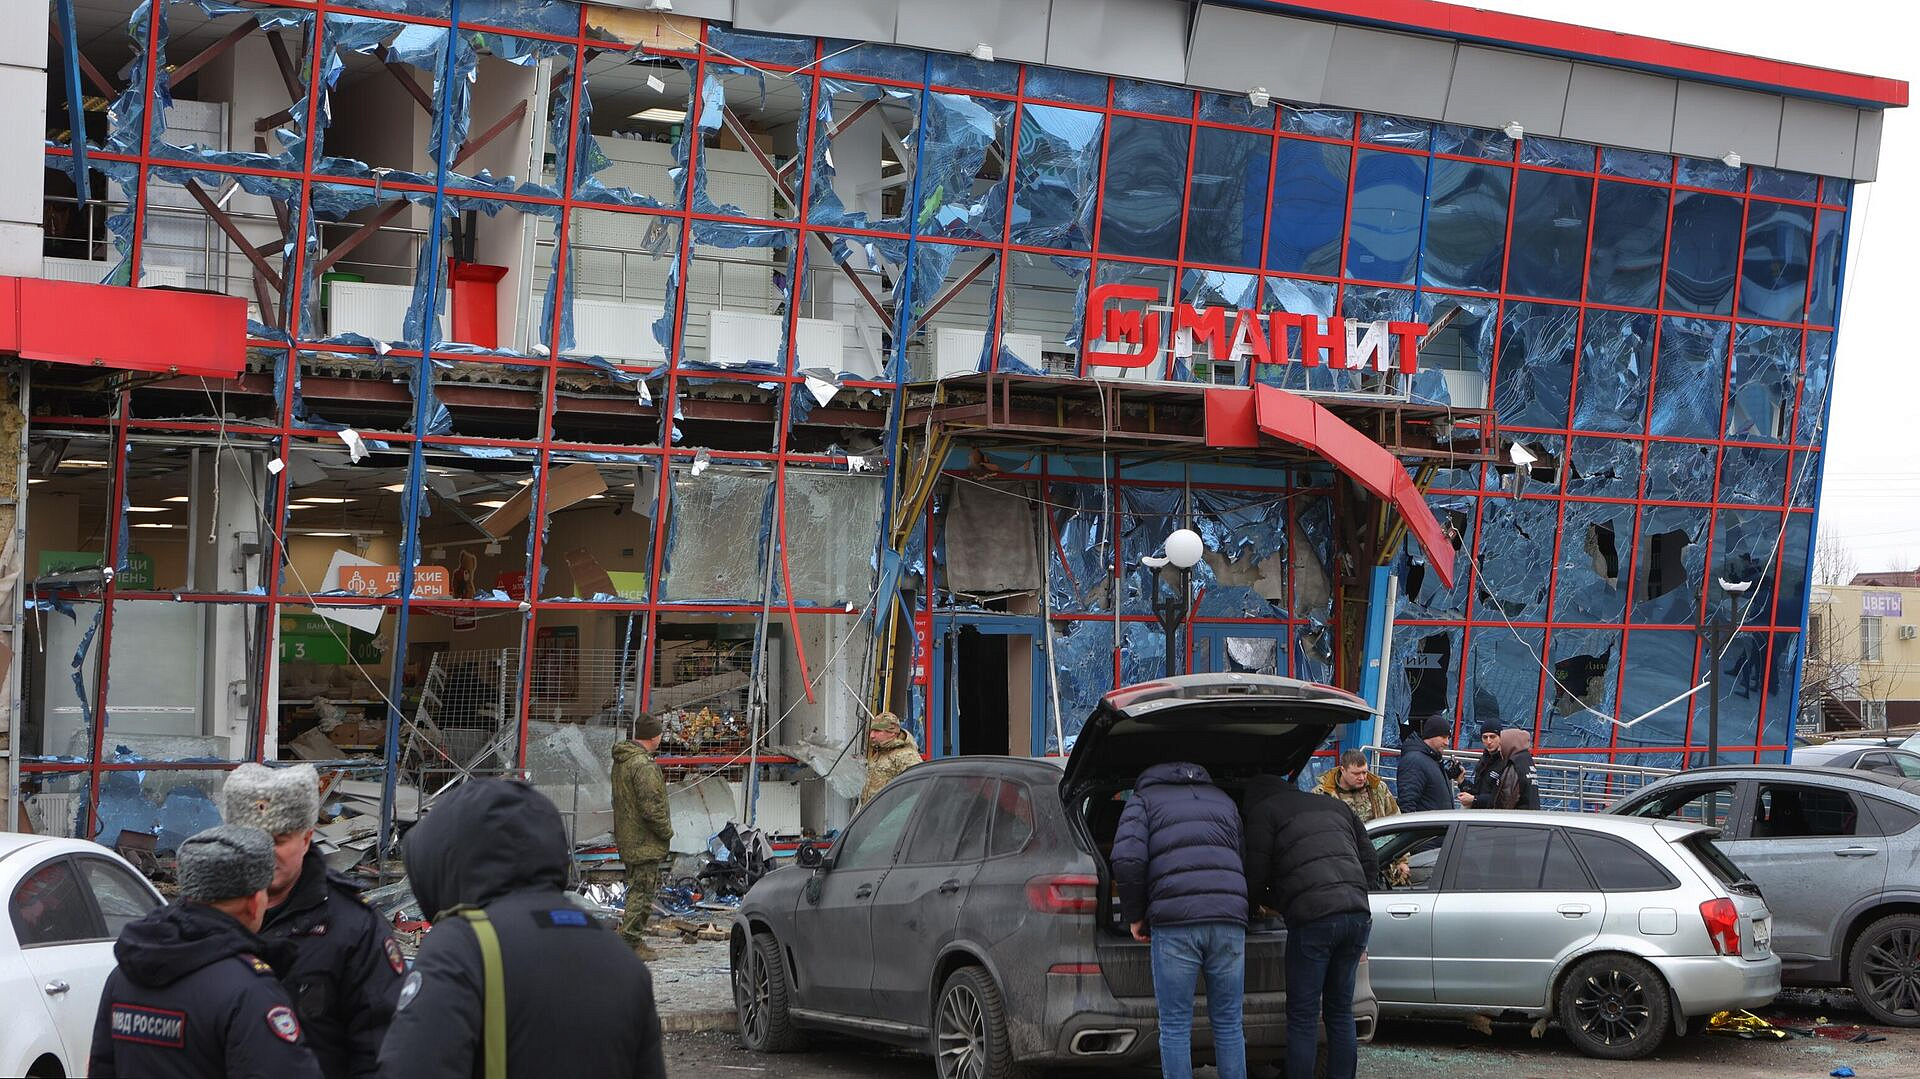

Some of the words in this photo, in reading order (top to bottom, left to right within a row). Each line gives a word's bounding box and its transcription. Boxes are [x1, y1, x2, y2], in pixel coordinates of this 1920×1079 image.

[1175, 302, 1429, 374] МАГНИТ
[386, 571, 443, 583] ДЕКИЕ
[390, 584, 443, 595] ТАРЫ
[1862, 595, 1901, 612] ЦВЕТЫ
[112, 1010, 132, 1034] МВД
[133, 1013, 182, 1038] РОССИИ
